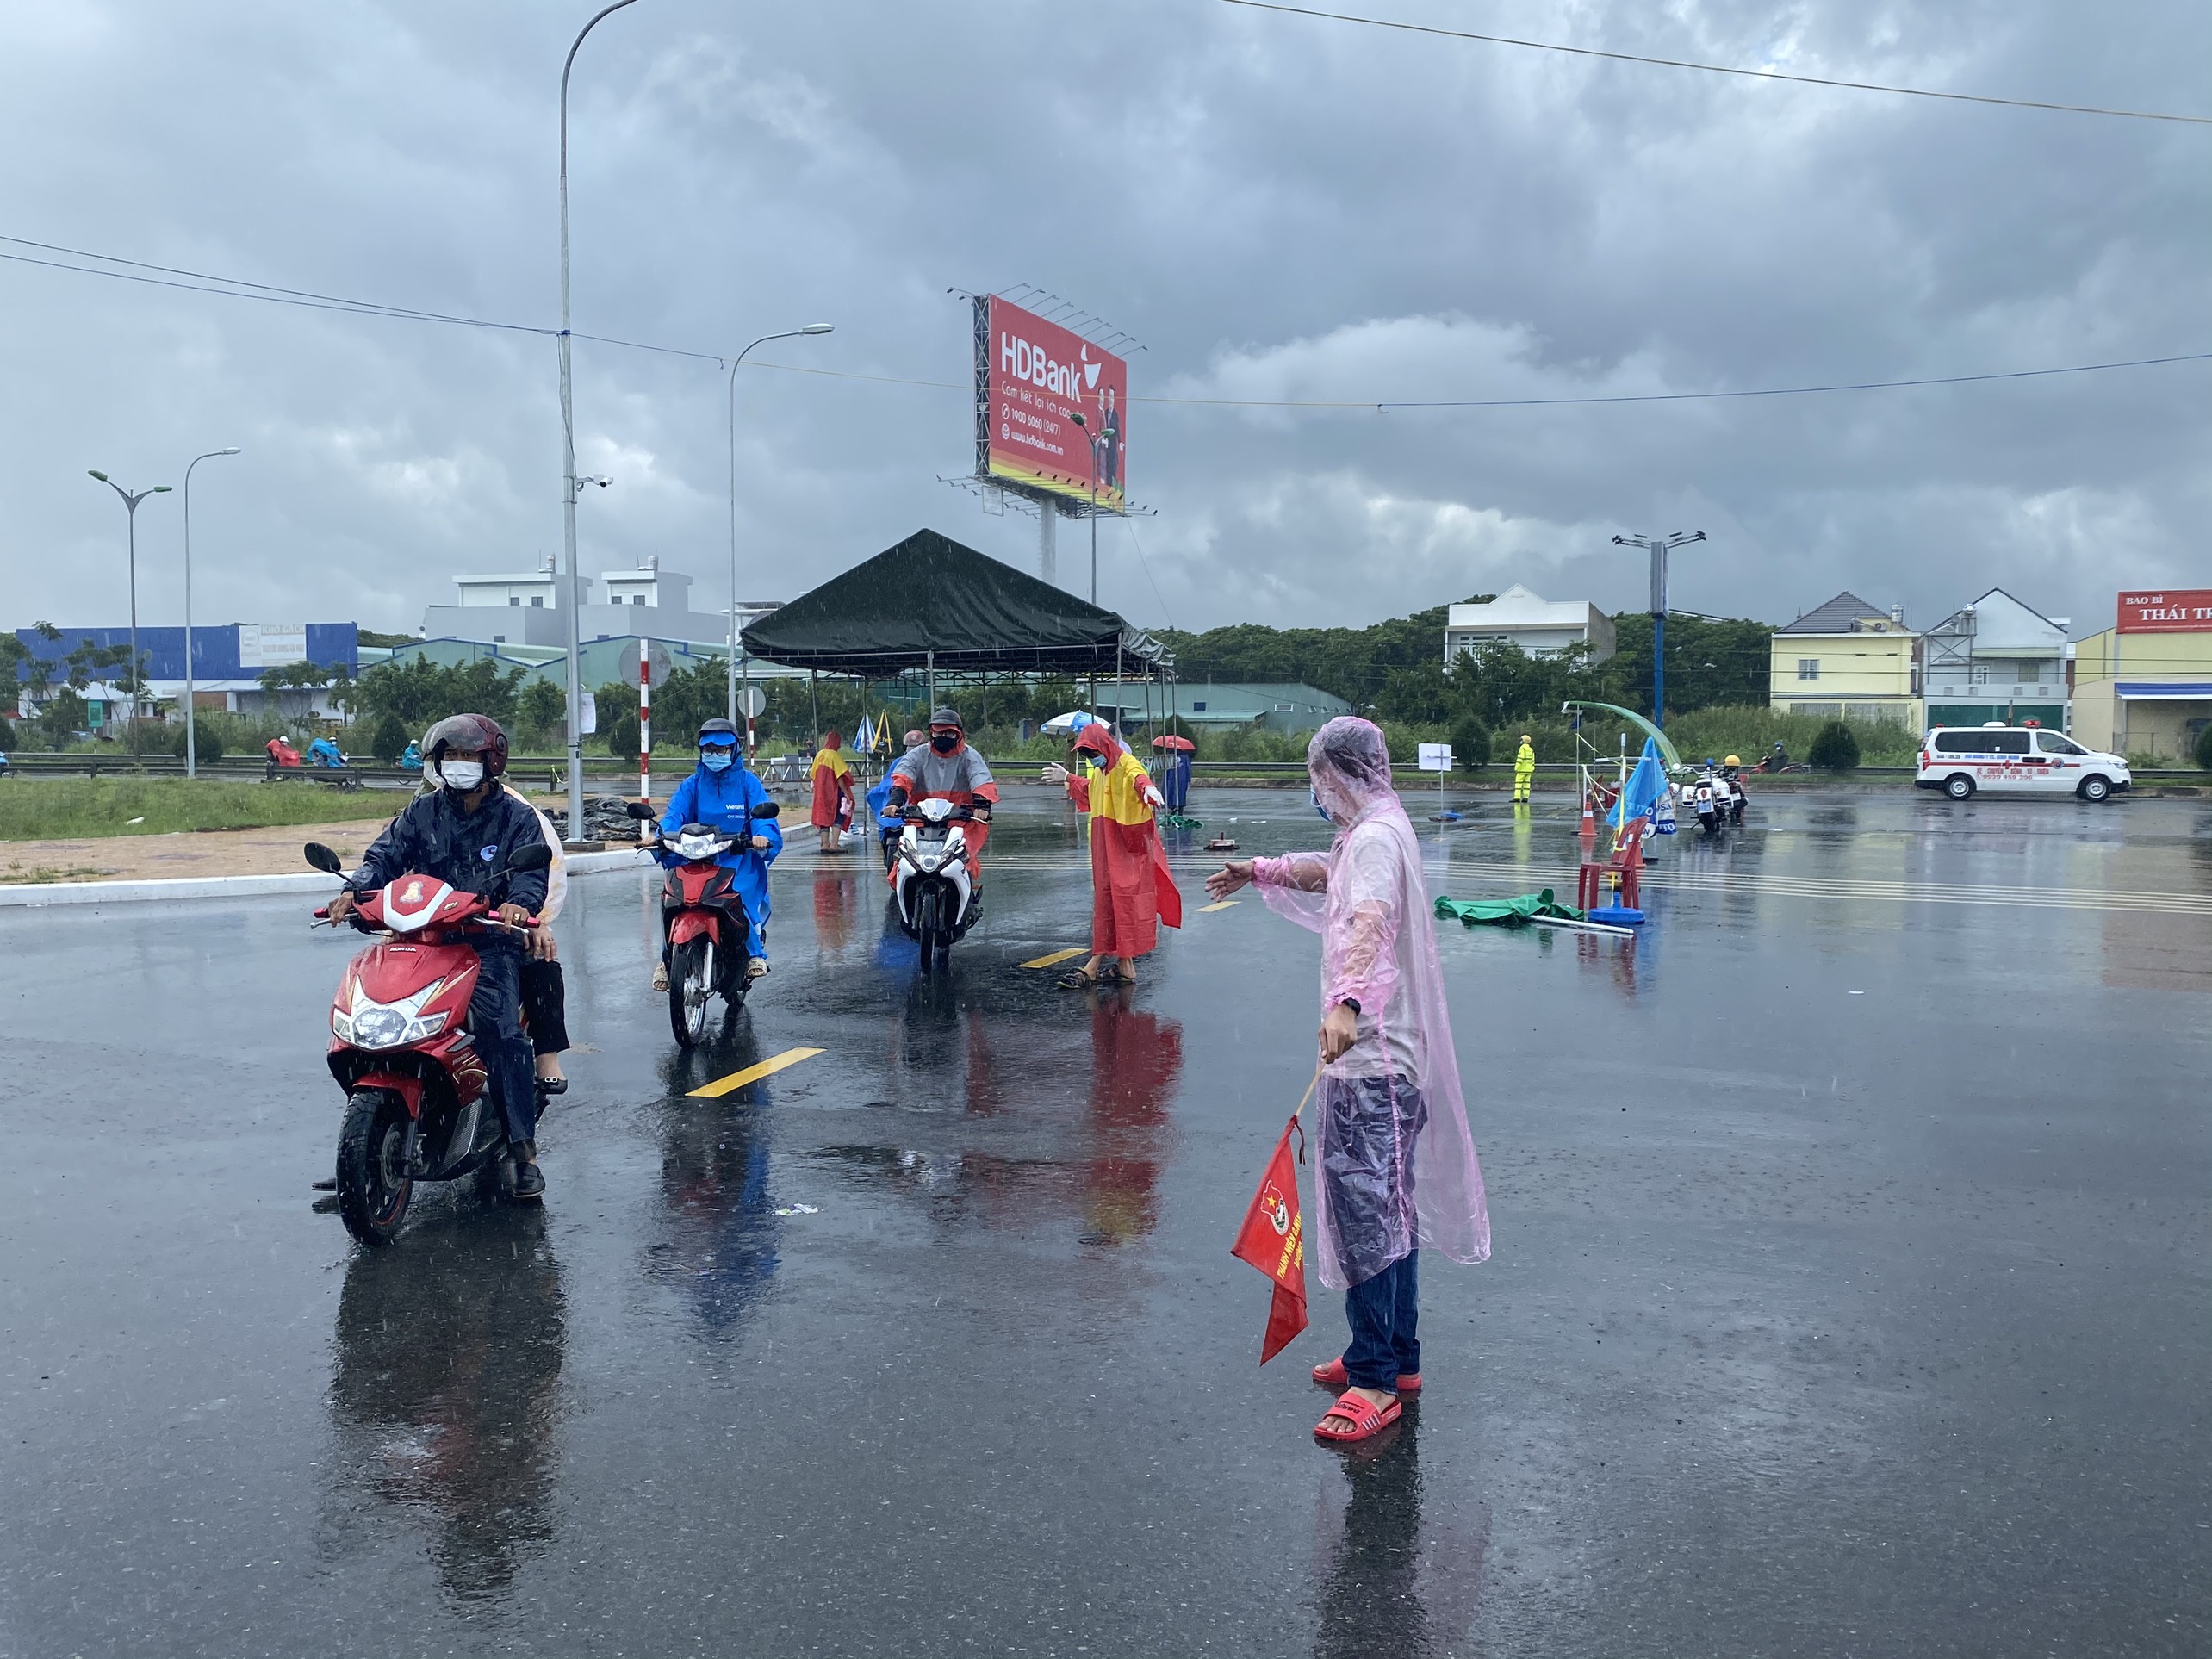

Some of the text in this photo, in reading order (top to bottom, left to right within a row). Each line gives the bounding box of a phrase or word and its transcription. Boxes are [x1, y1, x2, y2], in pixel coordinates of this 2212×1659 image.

[1002, 331, 1082, 403] HDBank
[1002, 380, 1017, 399] Cam
[1011, 408, 1060, 438] 1900 6060 (24/7)
[1011, 431, 1064, 456] www.hdbank.com.vn
[2126, 593, 2164, 605] BAO BÌ
[2139, 604, 2188, 620] THÁI
[1277, 1251, 1290, 1280] THANH
[1284, 1233, 1296, 1257] NIÊN
